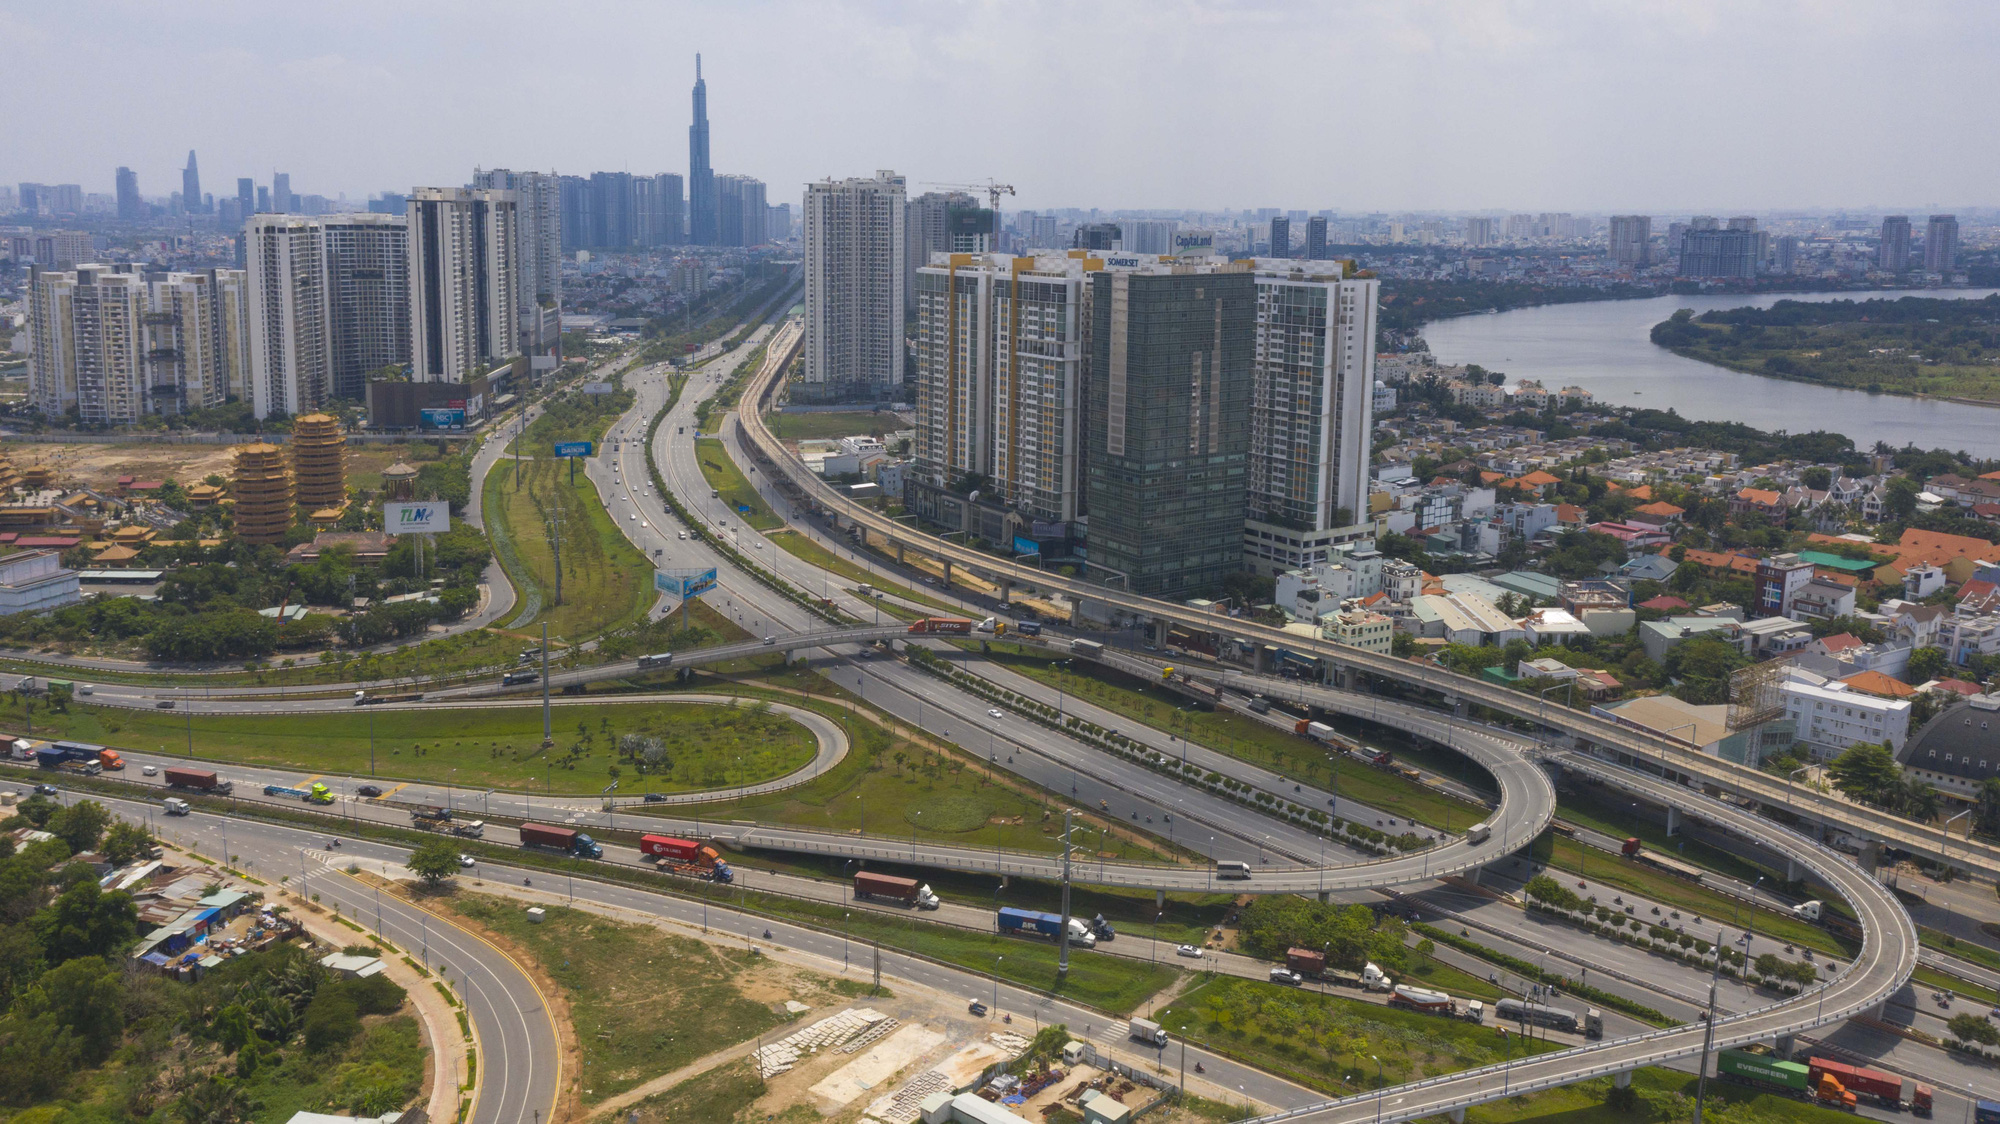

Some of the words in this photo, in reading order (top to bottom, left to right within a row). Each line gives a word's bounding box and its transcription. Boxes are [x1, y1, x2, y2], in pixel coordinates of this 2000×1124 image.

[1176, 234, 1212, 247] CapitaLand
[1107, 258, 1139, 267] SOMERSET
[1021, 922, 1038, 930] APL
[1736, 1062, 1788, 1080] EVERGREEN
